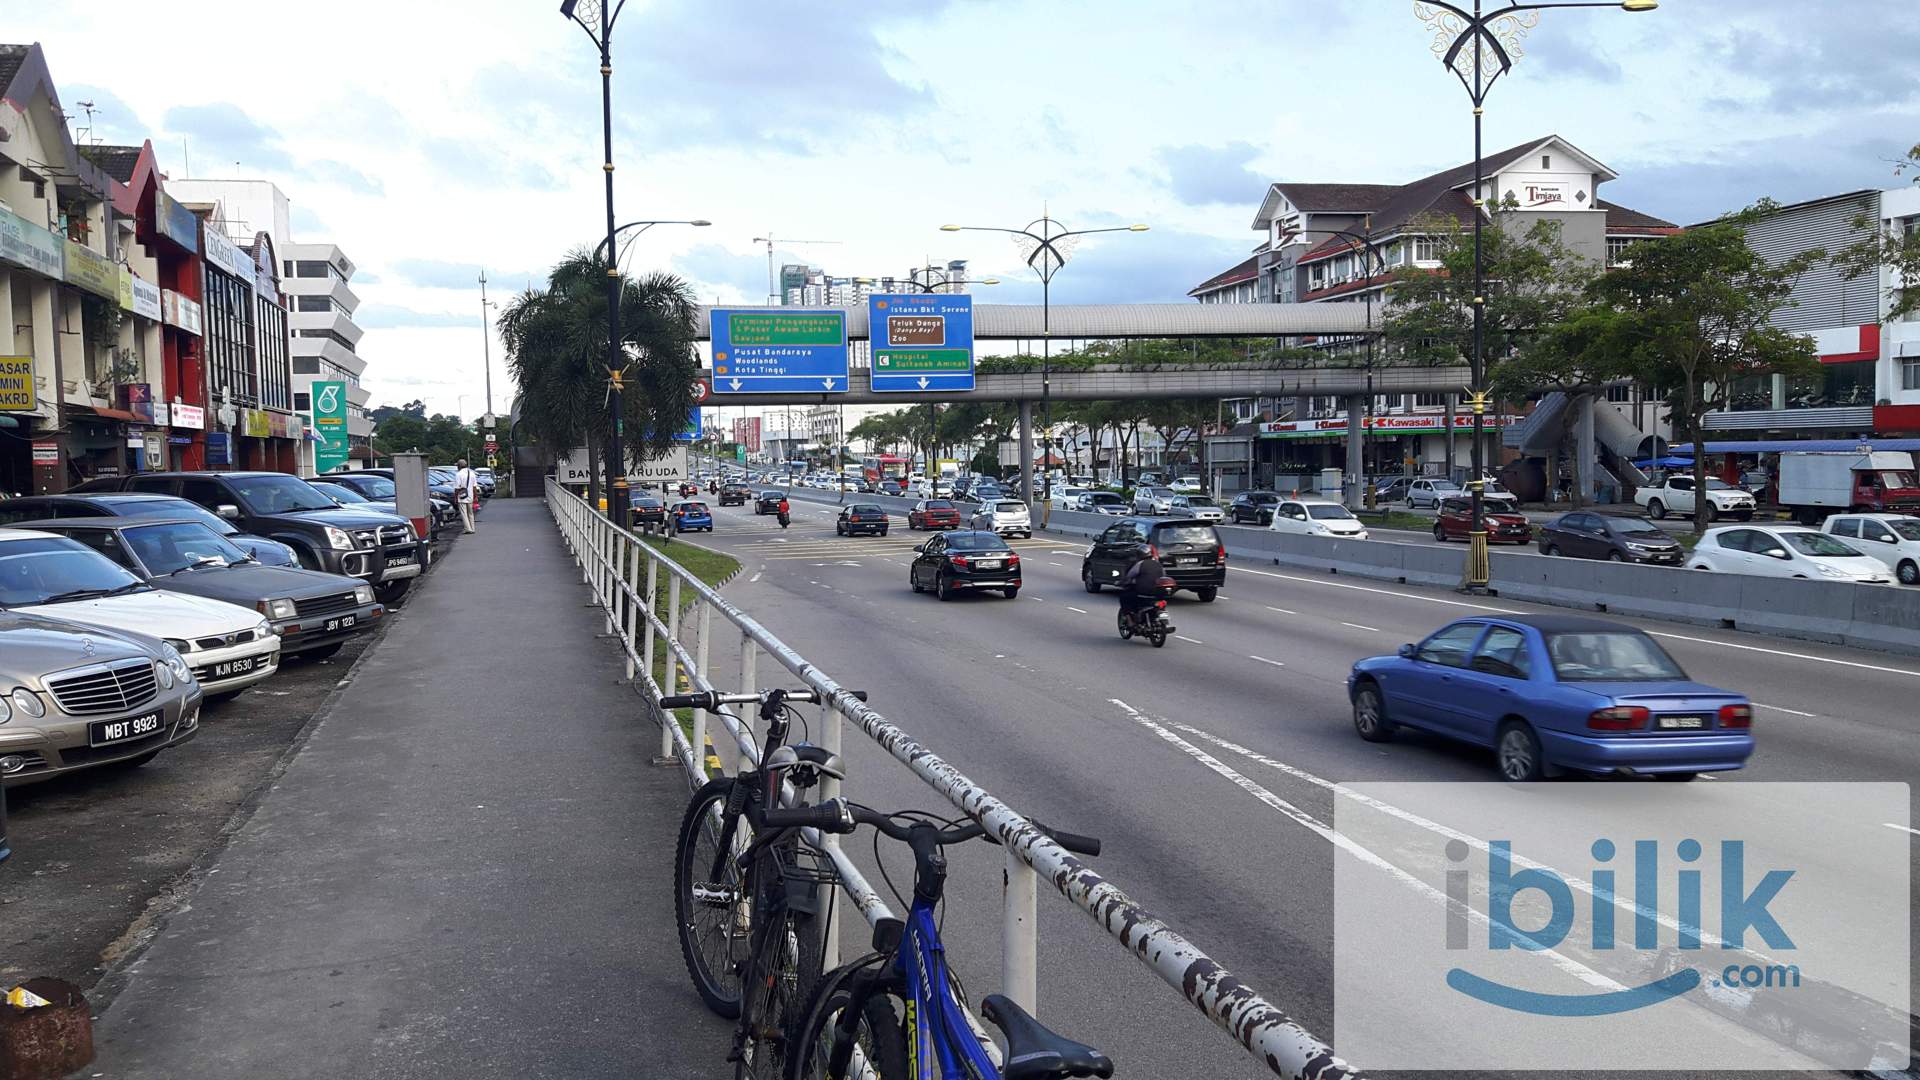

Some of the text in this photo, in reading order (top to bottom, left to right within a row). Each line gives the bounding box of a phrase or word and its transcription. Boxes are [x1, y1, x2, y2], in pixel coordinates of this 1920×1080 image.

[917, 320, 941, 328] Danga
[734, 348, 812, 357] Pusat Bandaraya
[735, 357, 778, 365] Woodlands
[735, 366, 756, 374] Kota
[759, 366, 787, 376] Tinggi
[0, 378, 24, 390] MINI
[1388, 418, 1435, 427] Kawasaki
[656, 467, 679, 476] UDA
[326, 616, 355, 631] JBY 1221
[215, 659, 252, 677] WJN 8530
[104, 714, 157, 740] MBT 9923
